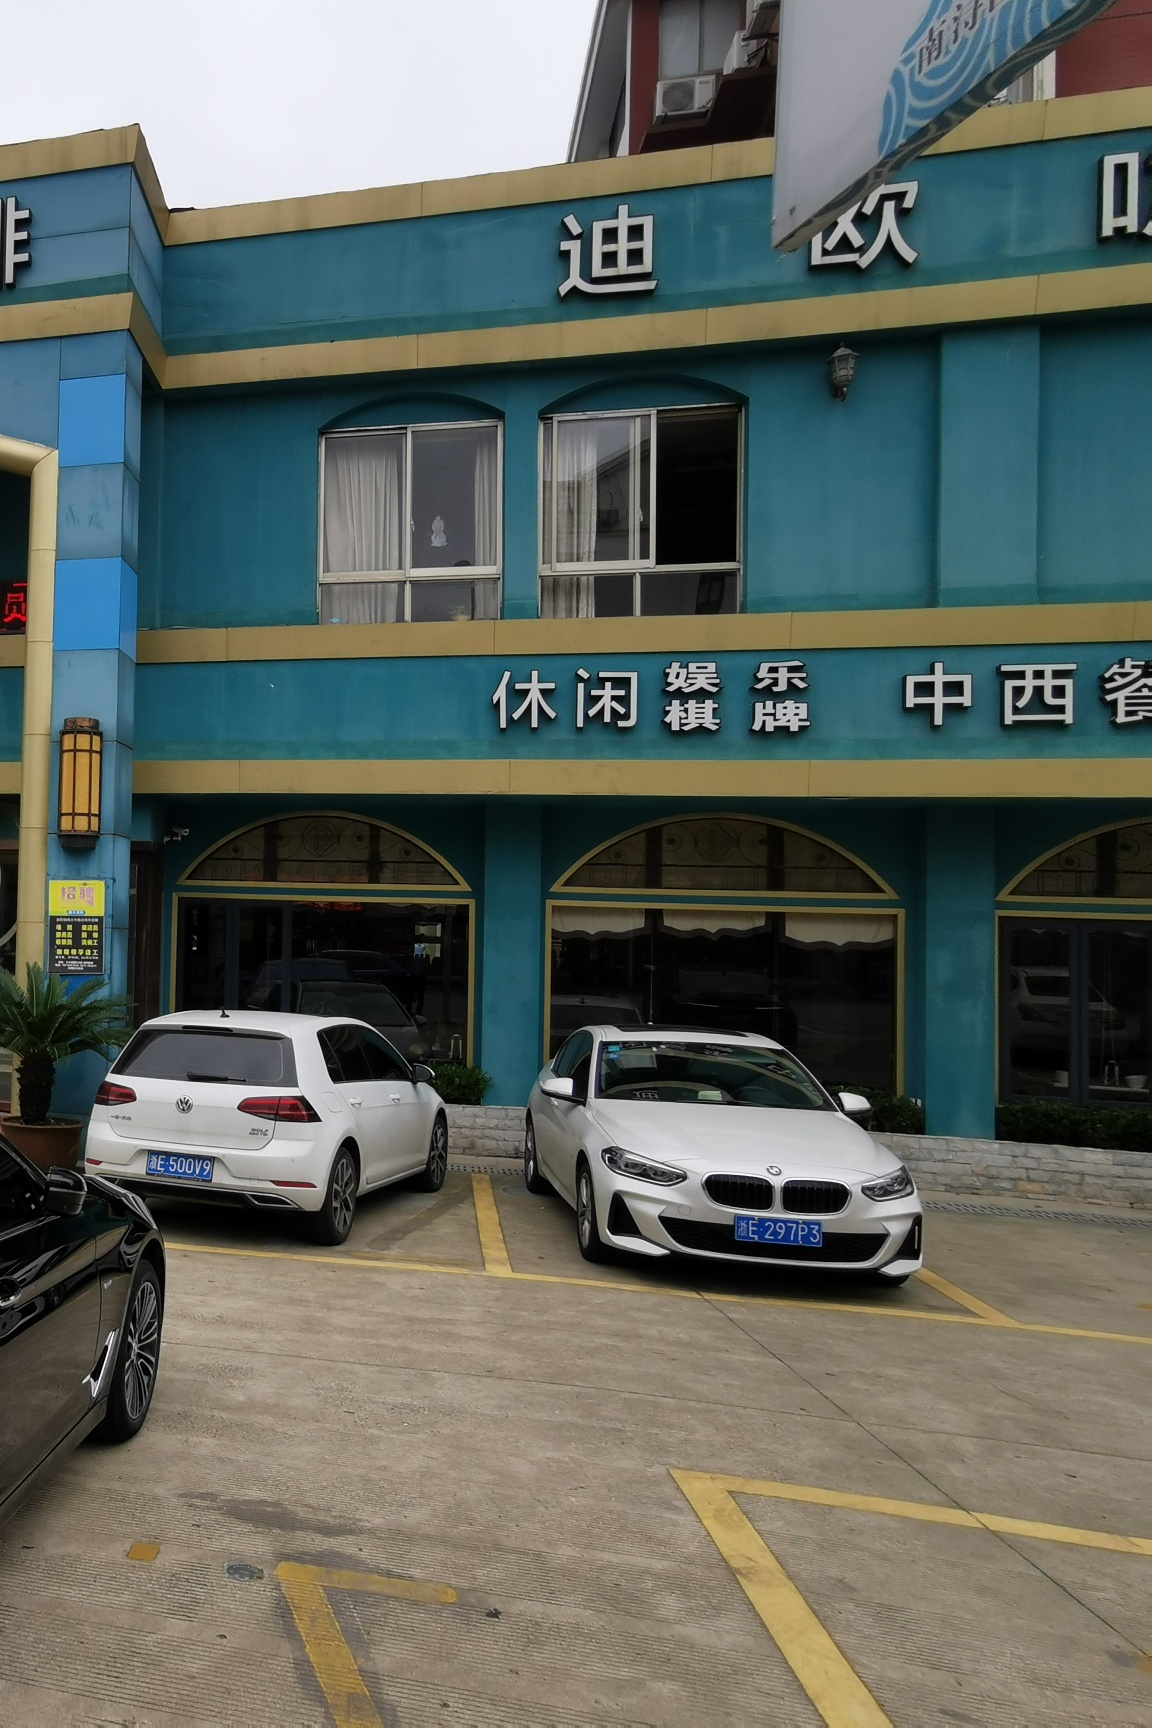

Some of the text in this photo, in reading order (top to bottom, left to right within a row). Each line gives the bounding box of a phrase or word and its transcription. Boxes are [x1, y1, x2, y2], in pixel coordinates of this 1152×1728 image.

[492, 667, 639, 729] 休闲
[664, 660, 809, 692] 娱乐
[664, 699, 811, 732] 棋牌
[61, 886, 95, 908] 招聘
